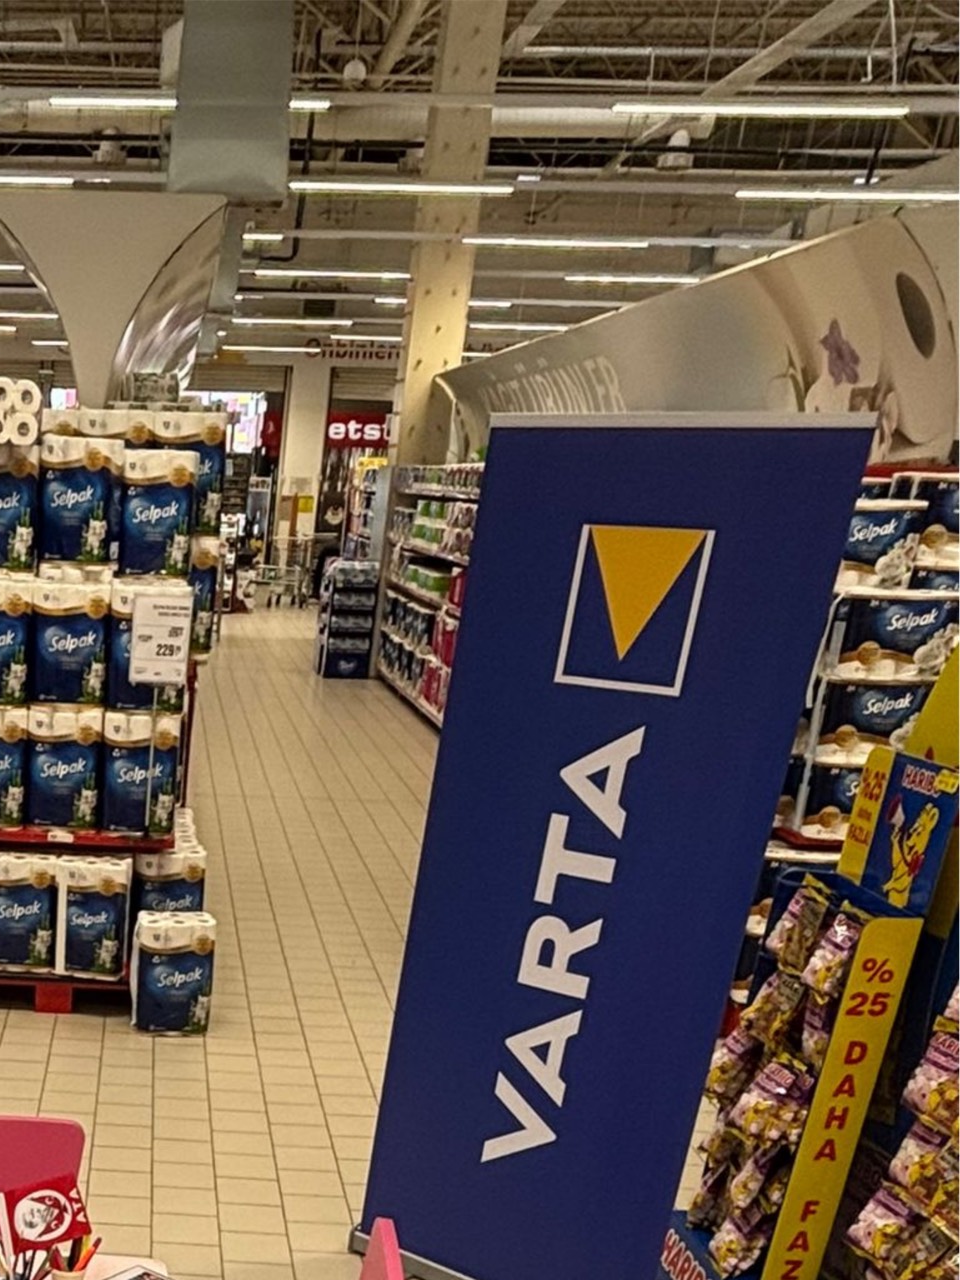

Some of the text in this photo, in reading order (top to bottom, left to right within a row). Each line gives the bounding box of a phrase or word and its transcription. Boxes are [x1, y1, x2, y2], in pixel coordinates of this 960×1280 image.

[50, 485, 93, 508] Selpak
[132, 500, 178, 524] Selpak
[847, 518, 898, 542] Selpak
[886, 608, 939, 632] Selpak
[48, 630, 96, 653] Selpak
[862, 692, 914, 716] Selpak
[41, 757, 87, 779] Selpak
[70, 911, 109, 927] Selpak
[481, 725, 646, 1163] VARTA
[156, 966, 204, 989] Selpak
[862, 957, 894, 984] %
[846, 991, 892, 1017] 25
[813, 1041, 868, 1162] DAHA
[69, 1187, 87, 1222] ATA
